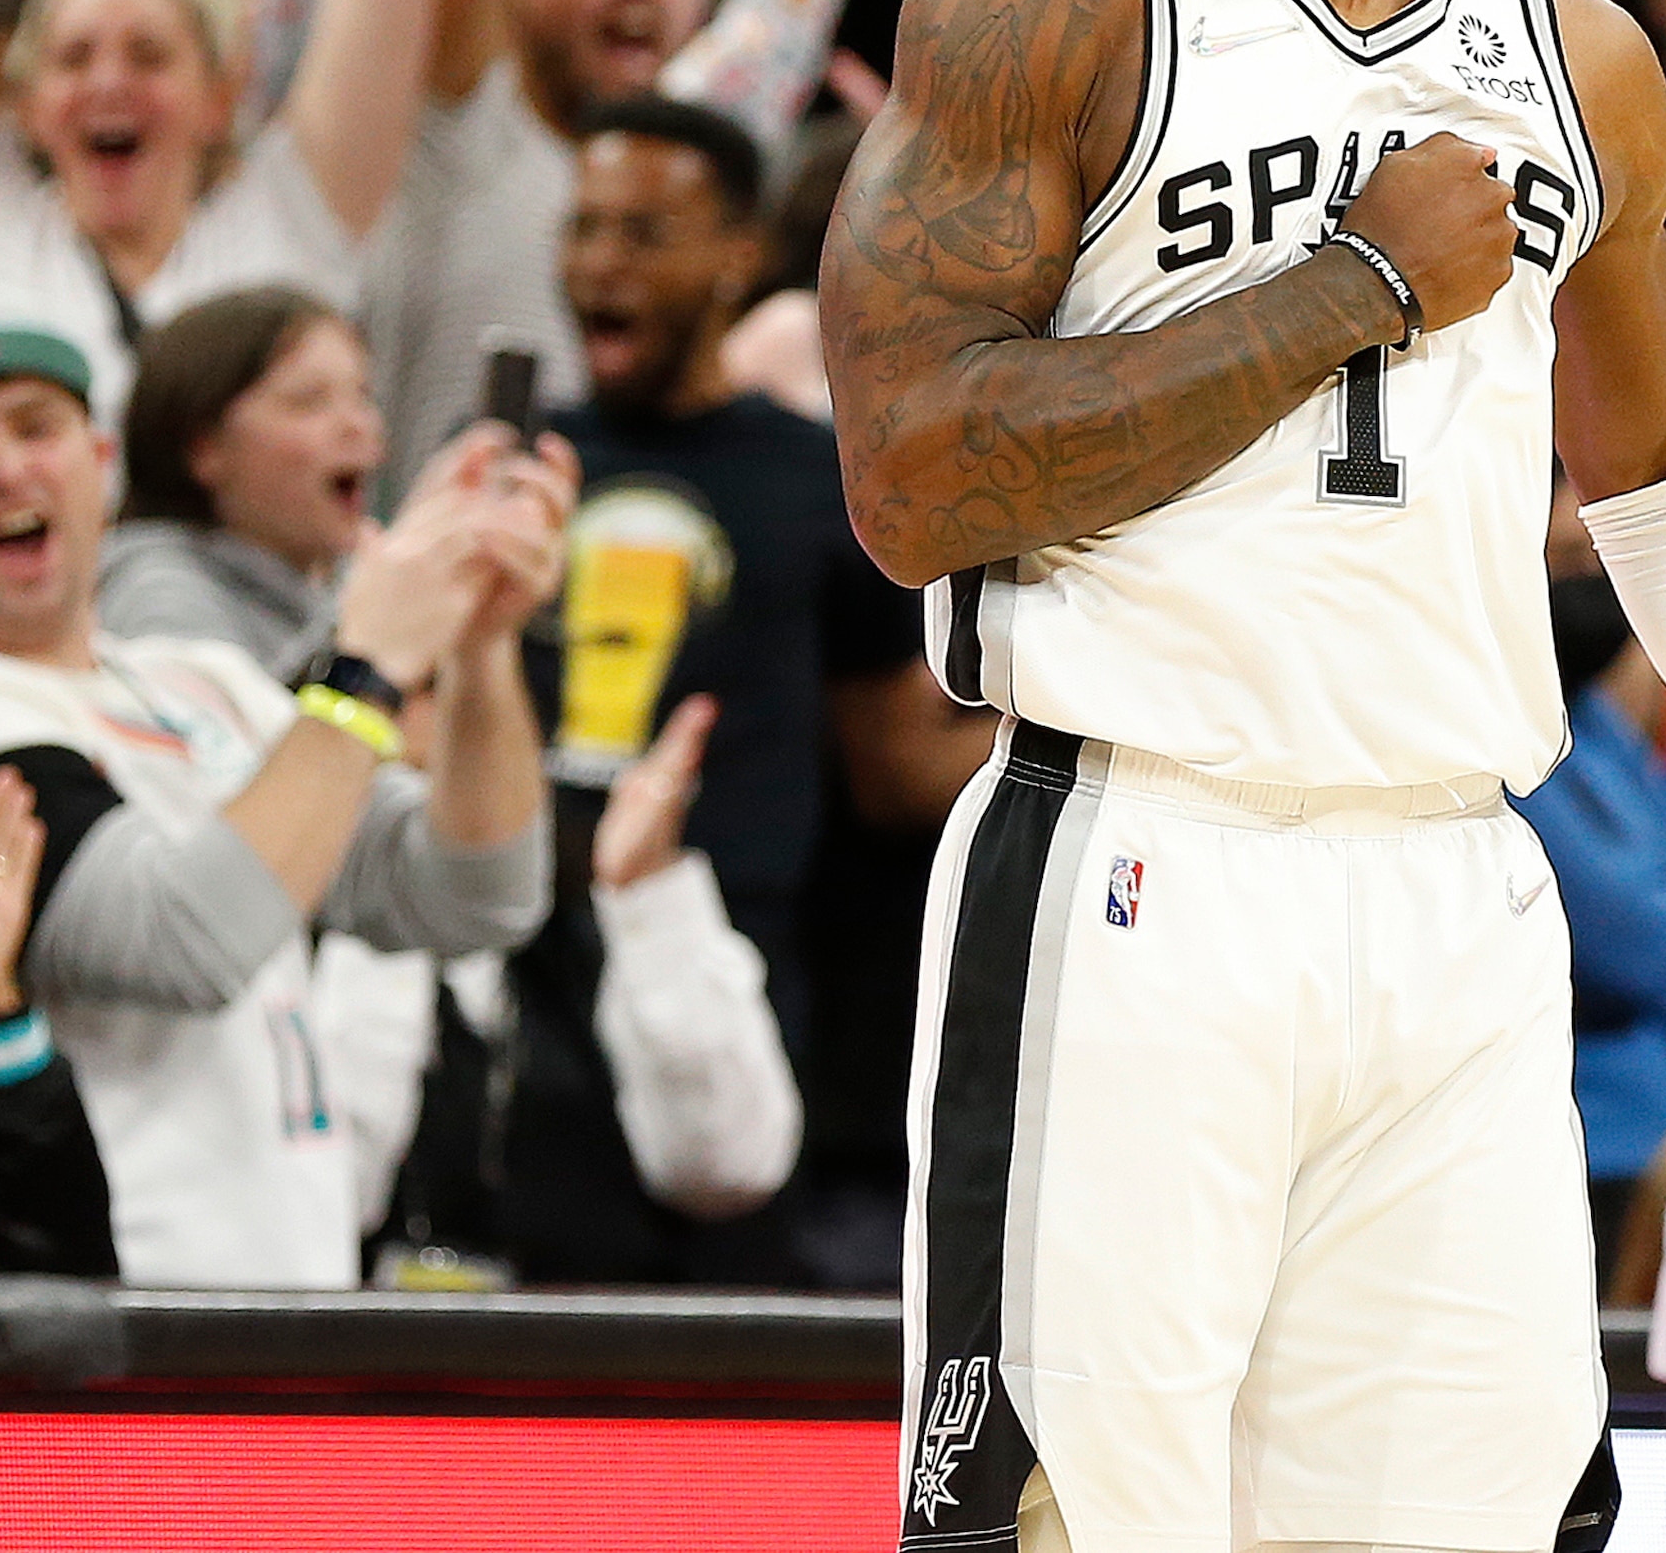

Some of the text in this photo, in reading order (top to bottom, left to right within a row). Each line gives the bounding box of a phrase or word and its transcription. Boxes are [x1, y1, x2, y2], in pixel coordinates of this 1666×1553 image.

[1451, 64, 1543, 106] Frost
[1156, 129, 1576, 275] SPS
[1316, 343, 1407, 507] 1
